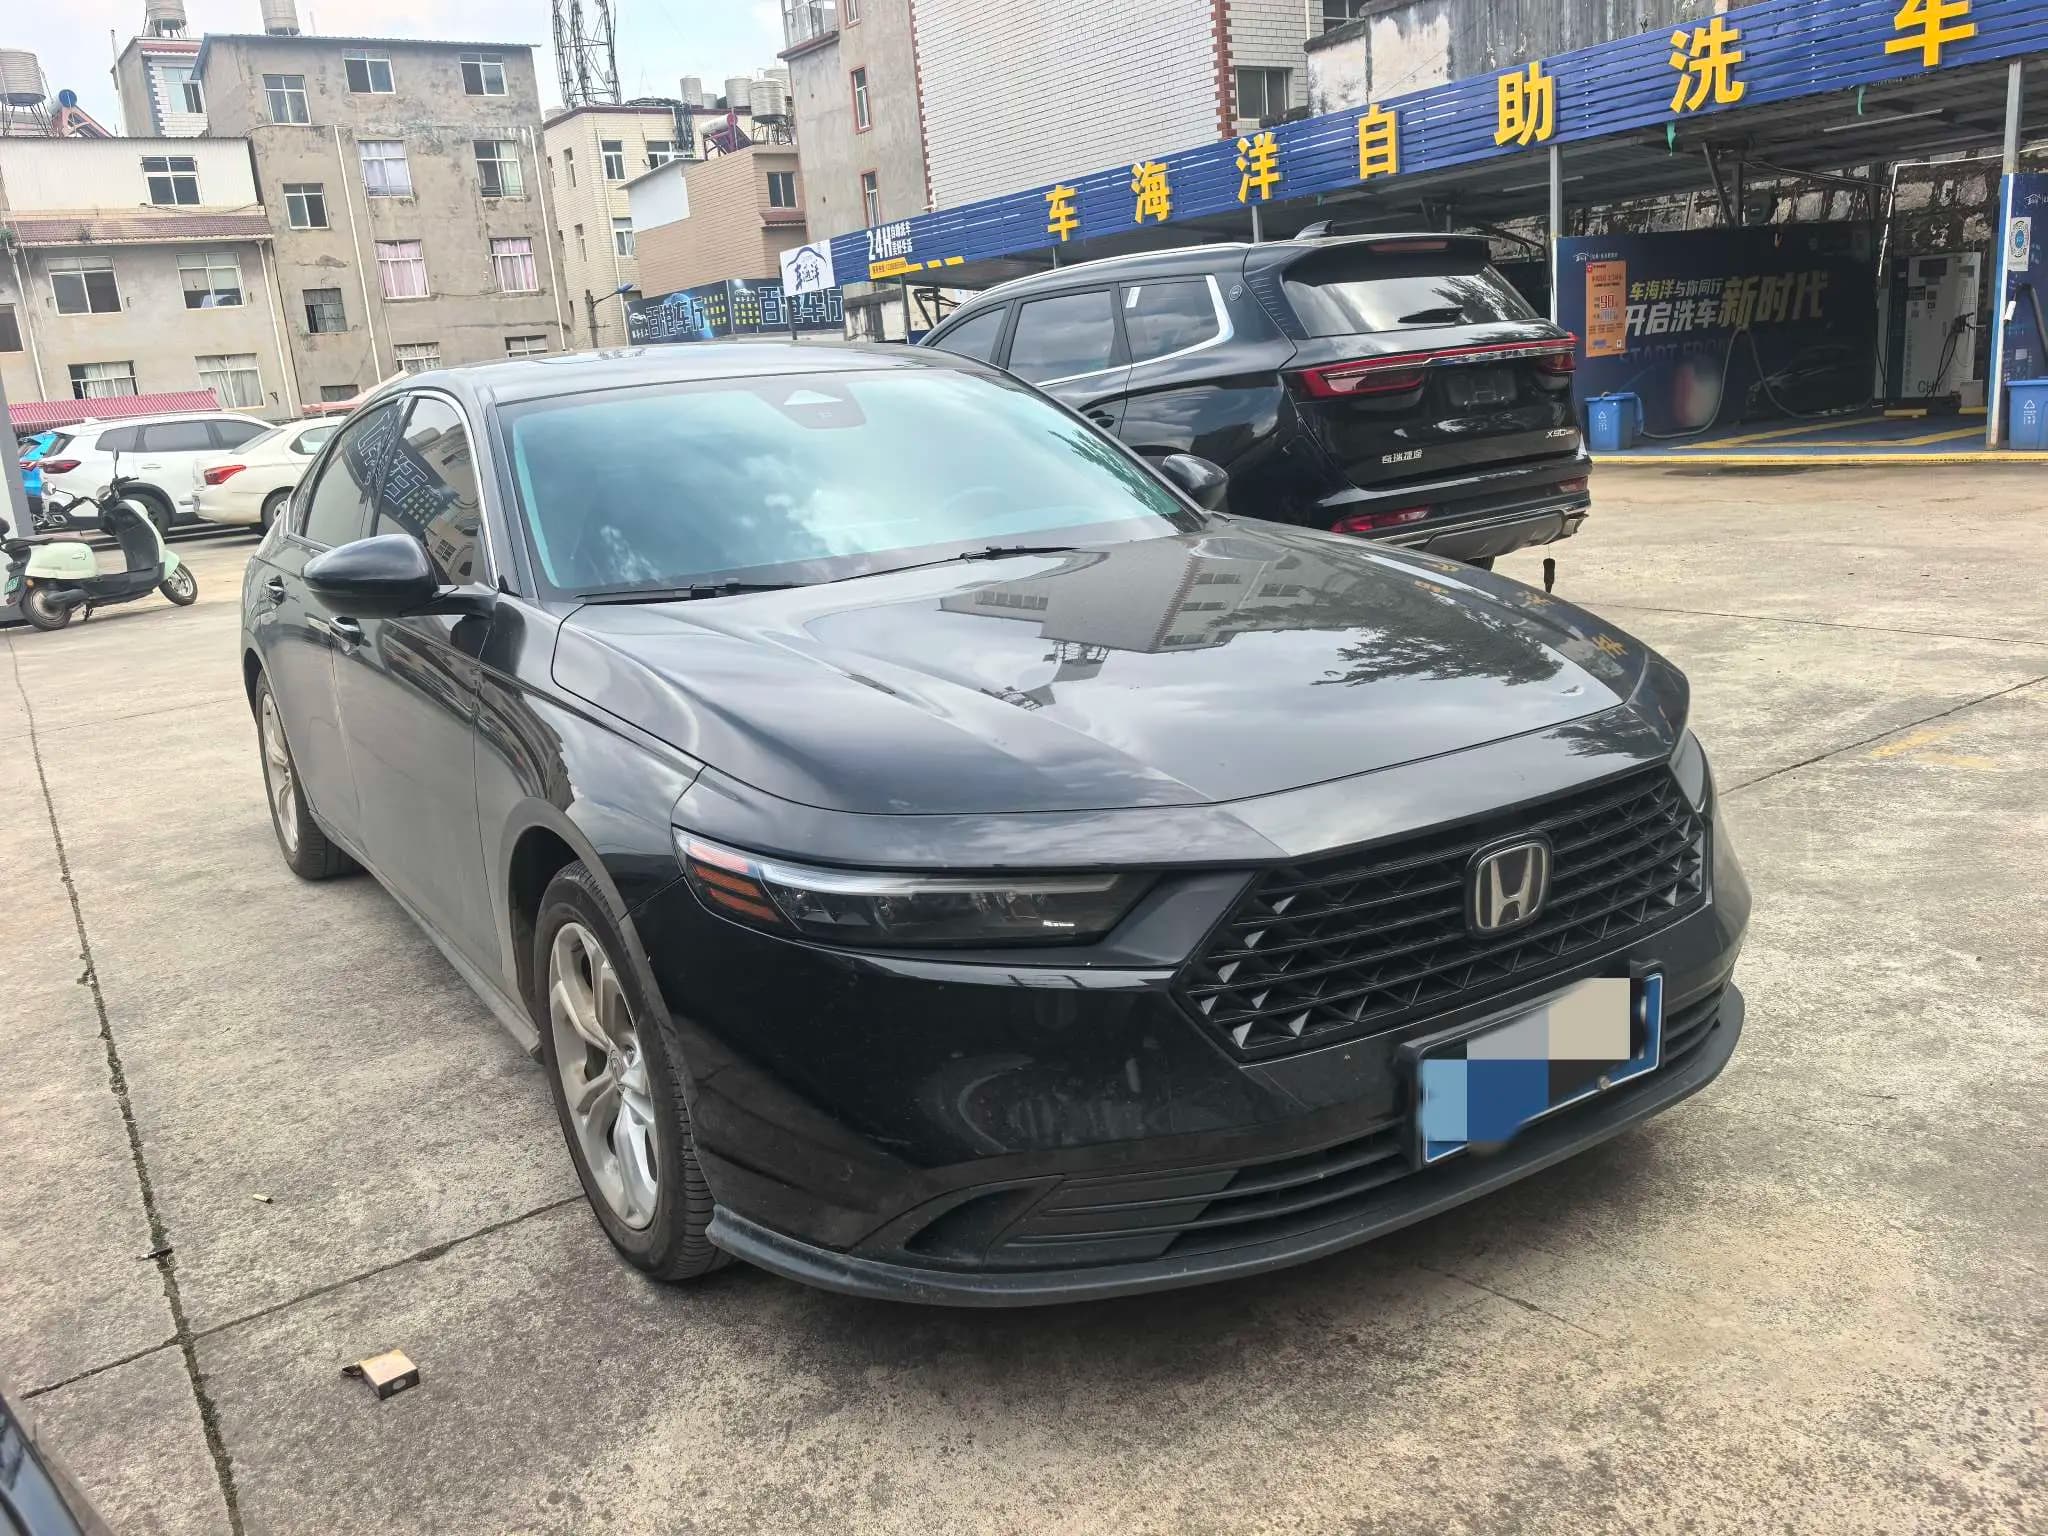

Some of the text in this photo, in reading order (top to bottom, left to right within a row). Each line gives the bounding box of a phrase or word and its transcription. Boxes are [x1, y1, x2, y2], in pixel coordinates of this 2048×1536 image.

[1045, 0, 1976, 242] 车海洋自助洗车
[866, 226, 893, 261] 24H
[1625, 270, 1829, 337] 开启洗车 新时代
[1629, 277, 1725, 301] 车海洋与你同行
